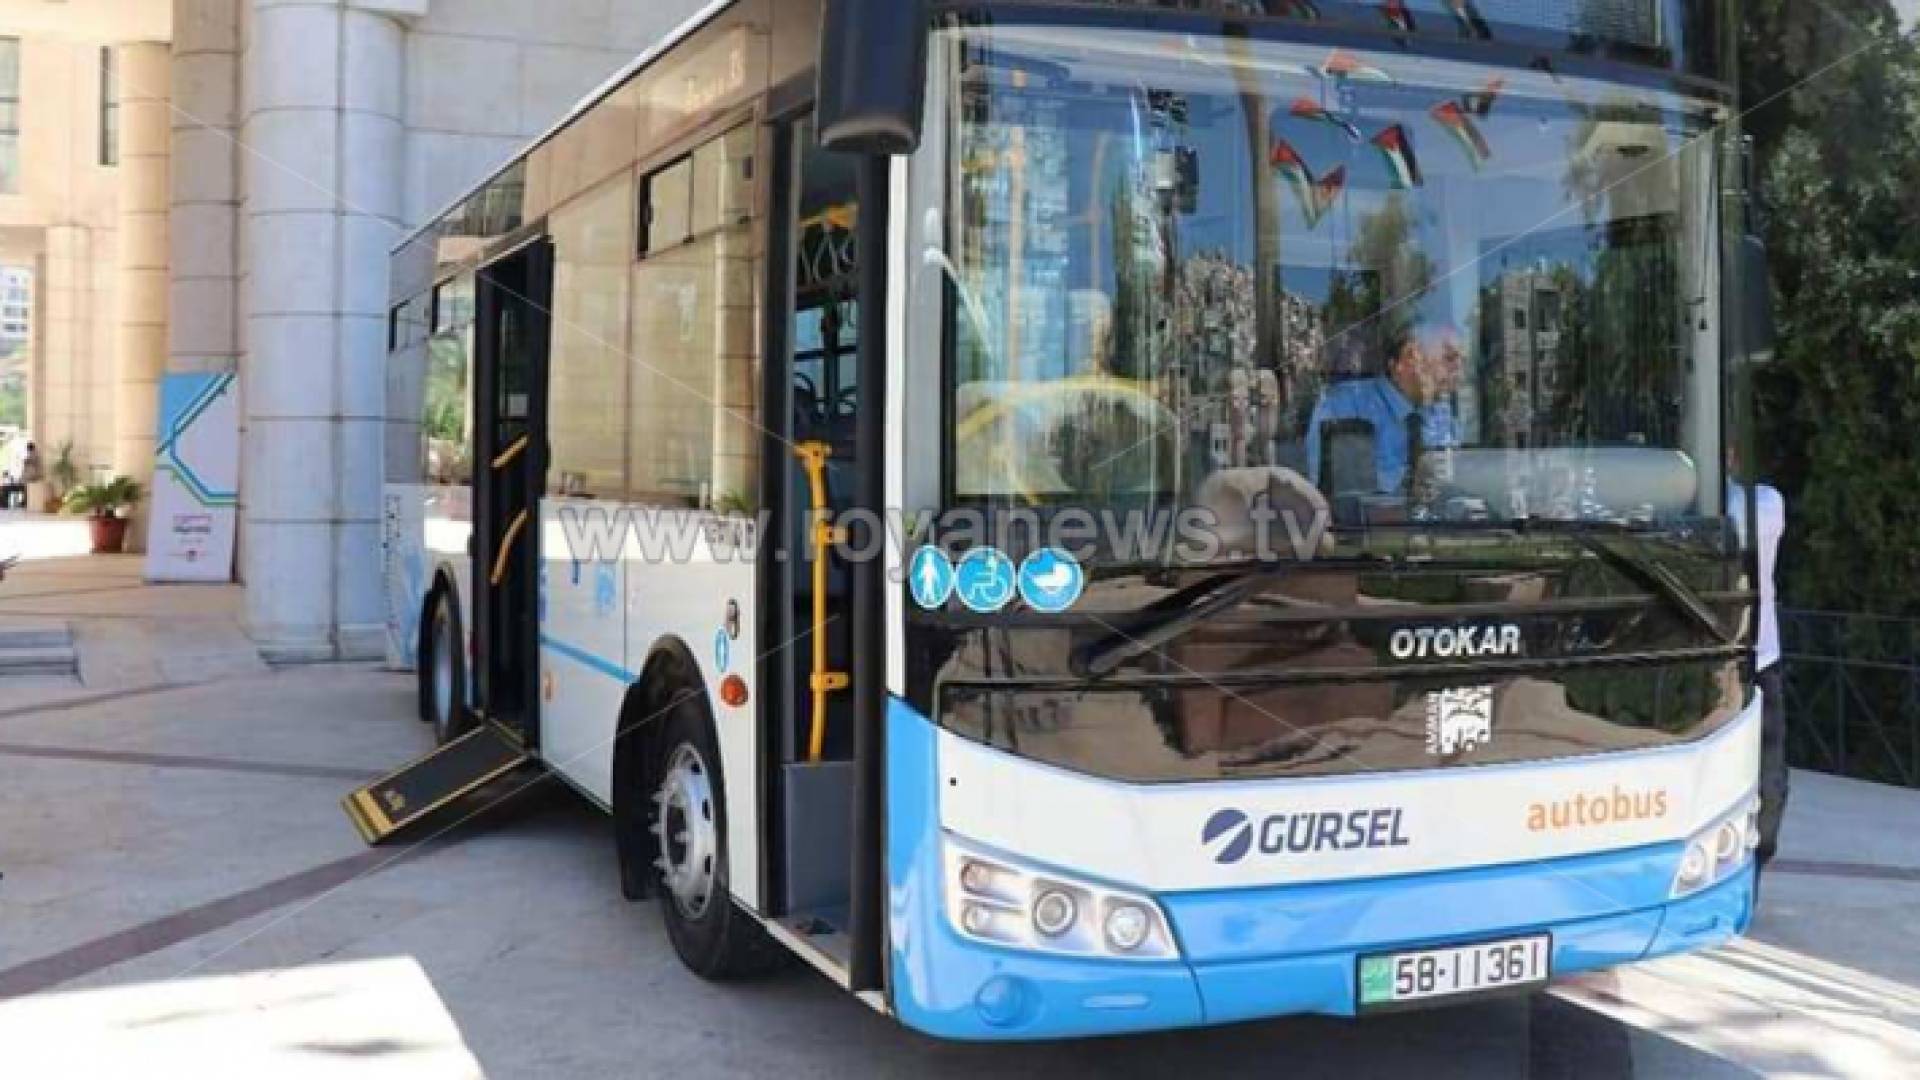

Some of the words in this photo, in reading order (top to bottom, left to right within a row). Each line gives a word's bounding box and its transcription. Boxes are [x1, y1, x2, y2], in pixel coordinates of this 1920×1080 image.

[1390, 624, 1520, 659] OTOKAR
[1258, 808, 1409, 855] GÜRSEL
[1526, 788, 1667, 832] autobus
